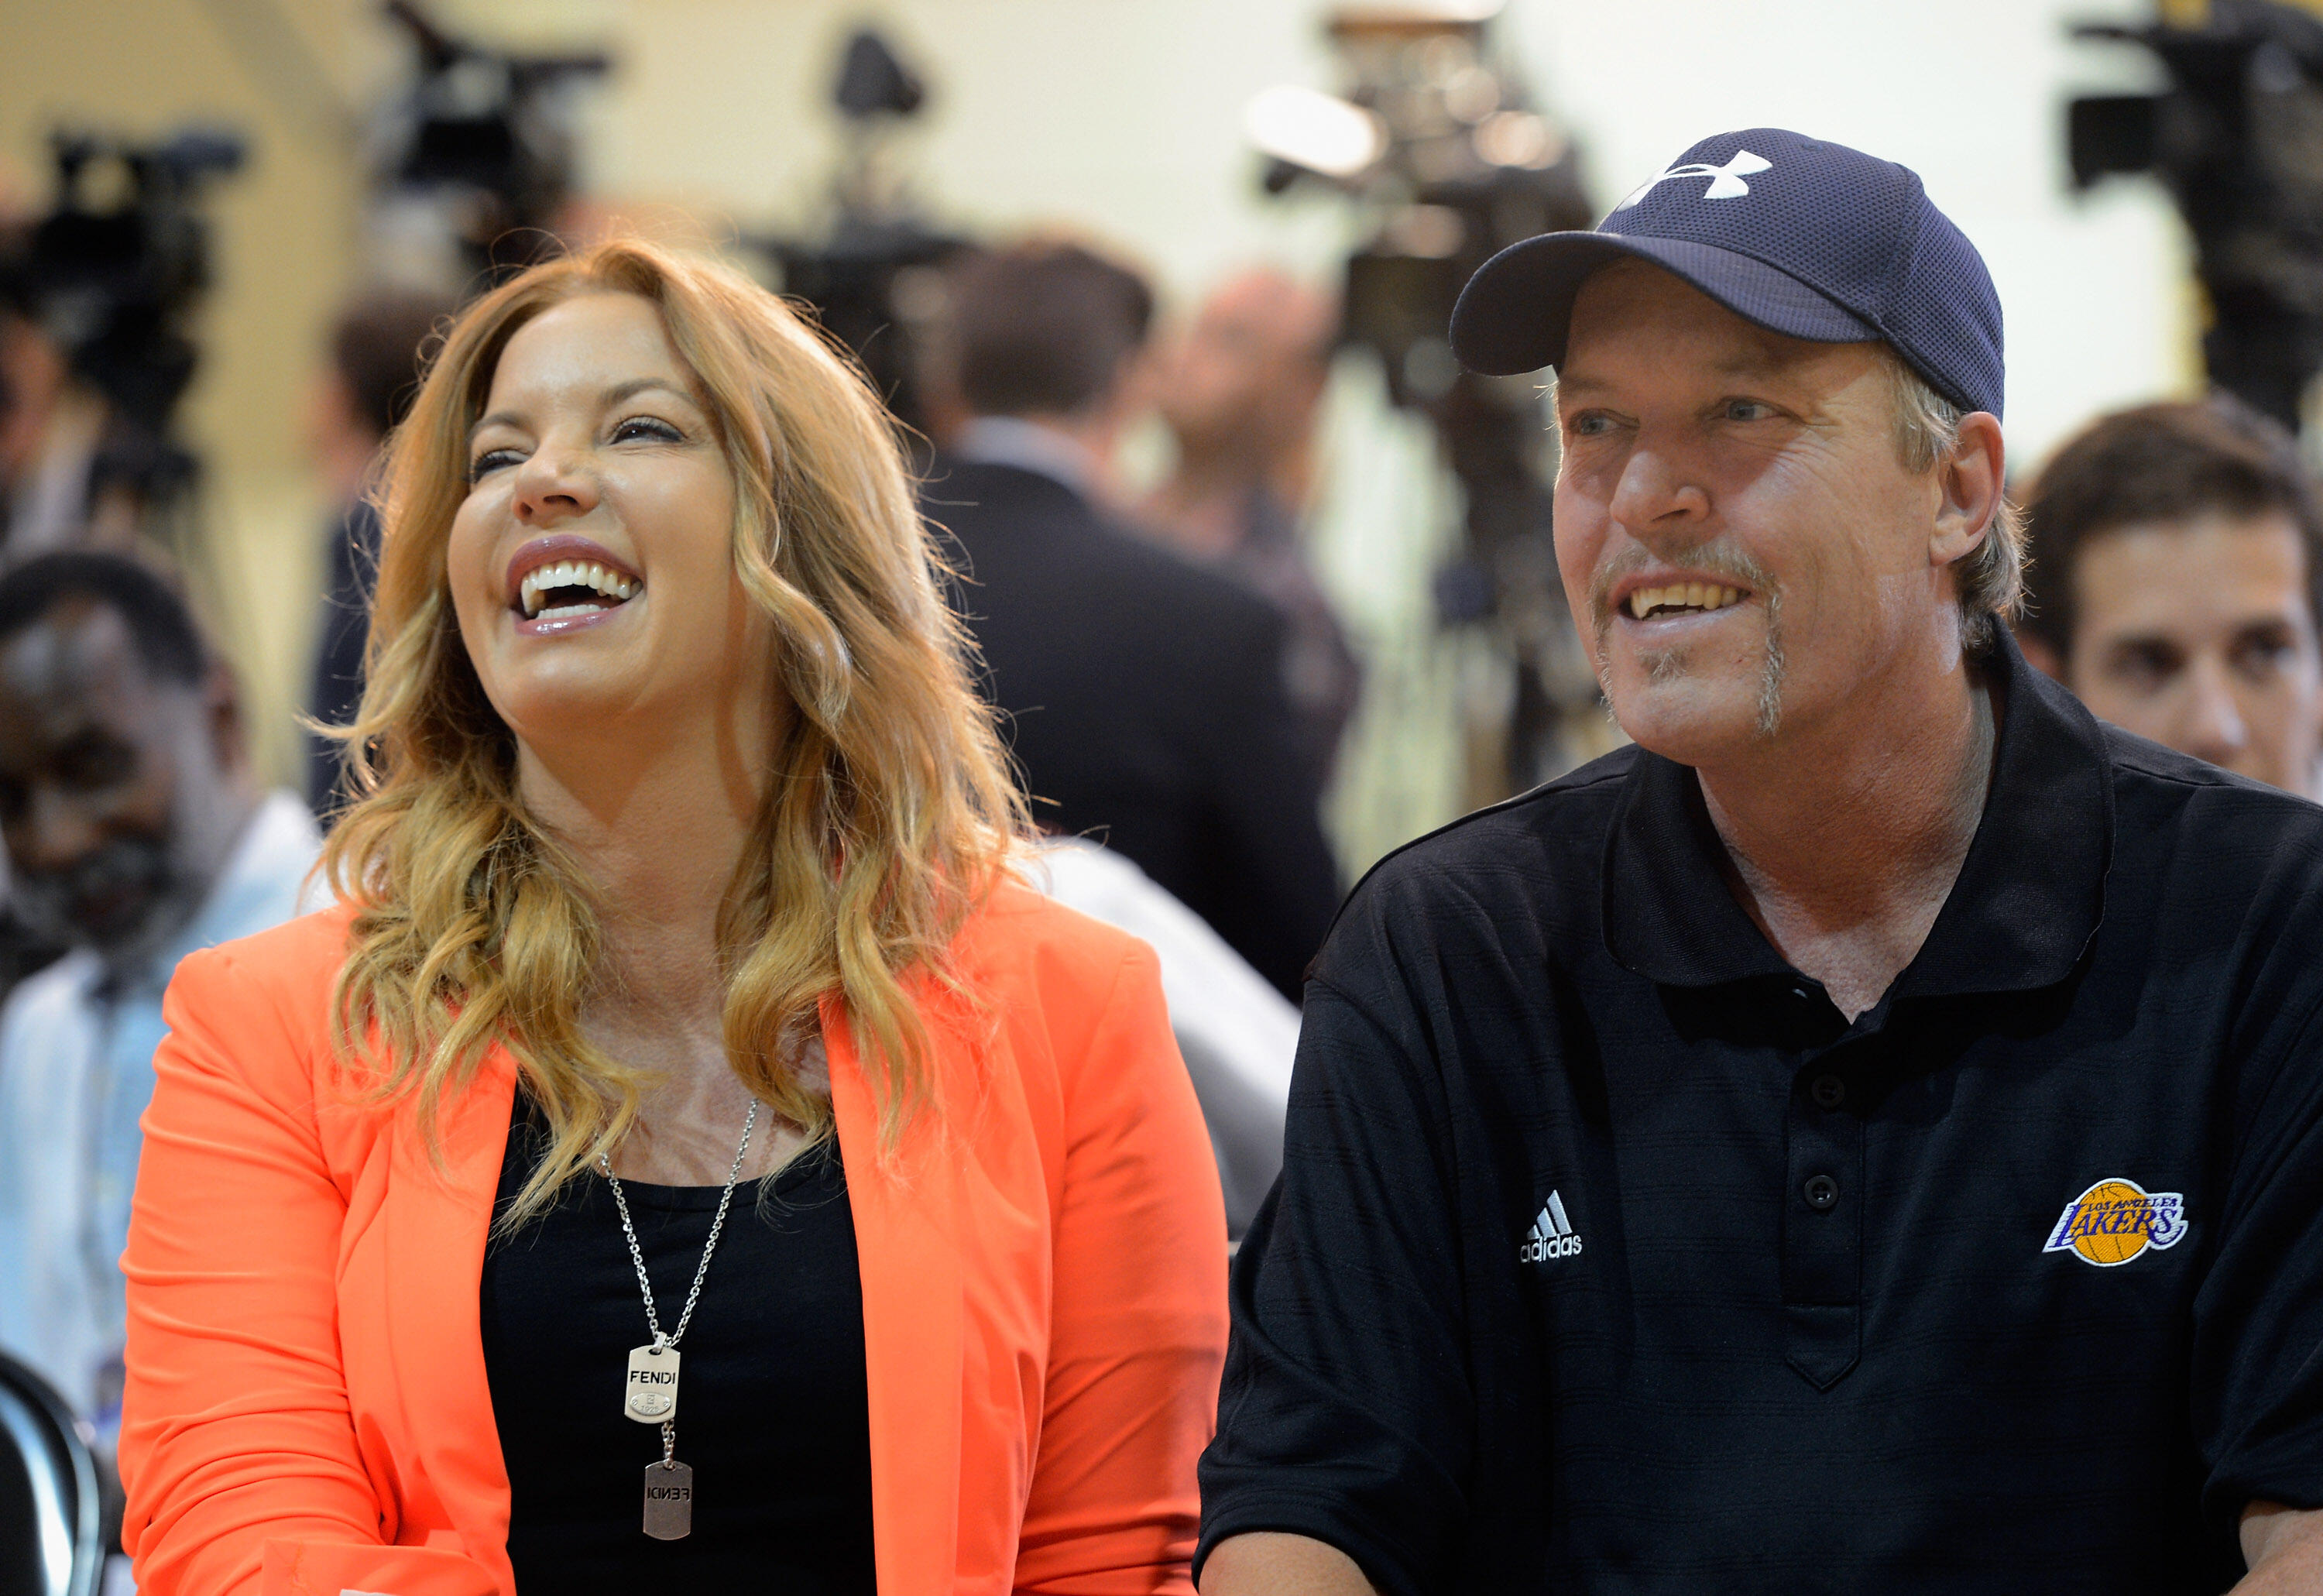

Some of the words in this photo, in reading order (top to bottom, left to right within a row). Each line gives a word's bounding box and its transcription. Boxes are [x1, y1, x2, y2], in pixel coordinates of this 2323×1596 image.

[2088, 1201, 2110, 1212] LOS
[2112, 1198, 2177, 1210] ANGELES
[2047, 1203, 2184, 1248] LAKERS
[1520, 1234, 1582, 1263] adidas
[630, 1371, 676, 1384] FENDI
